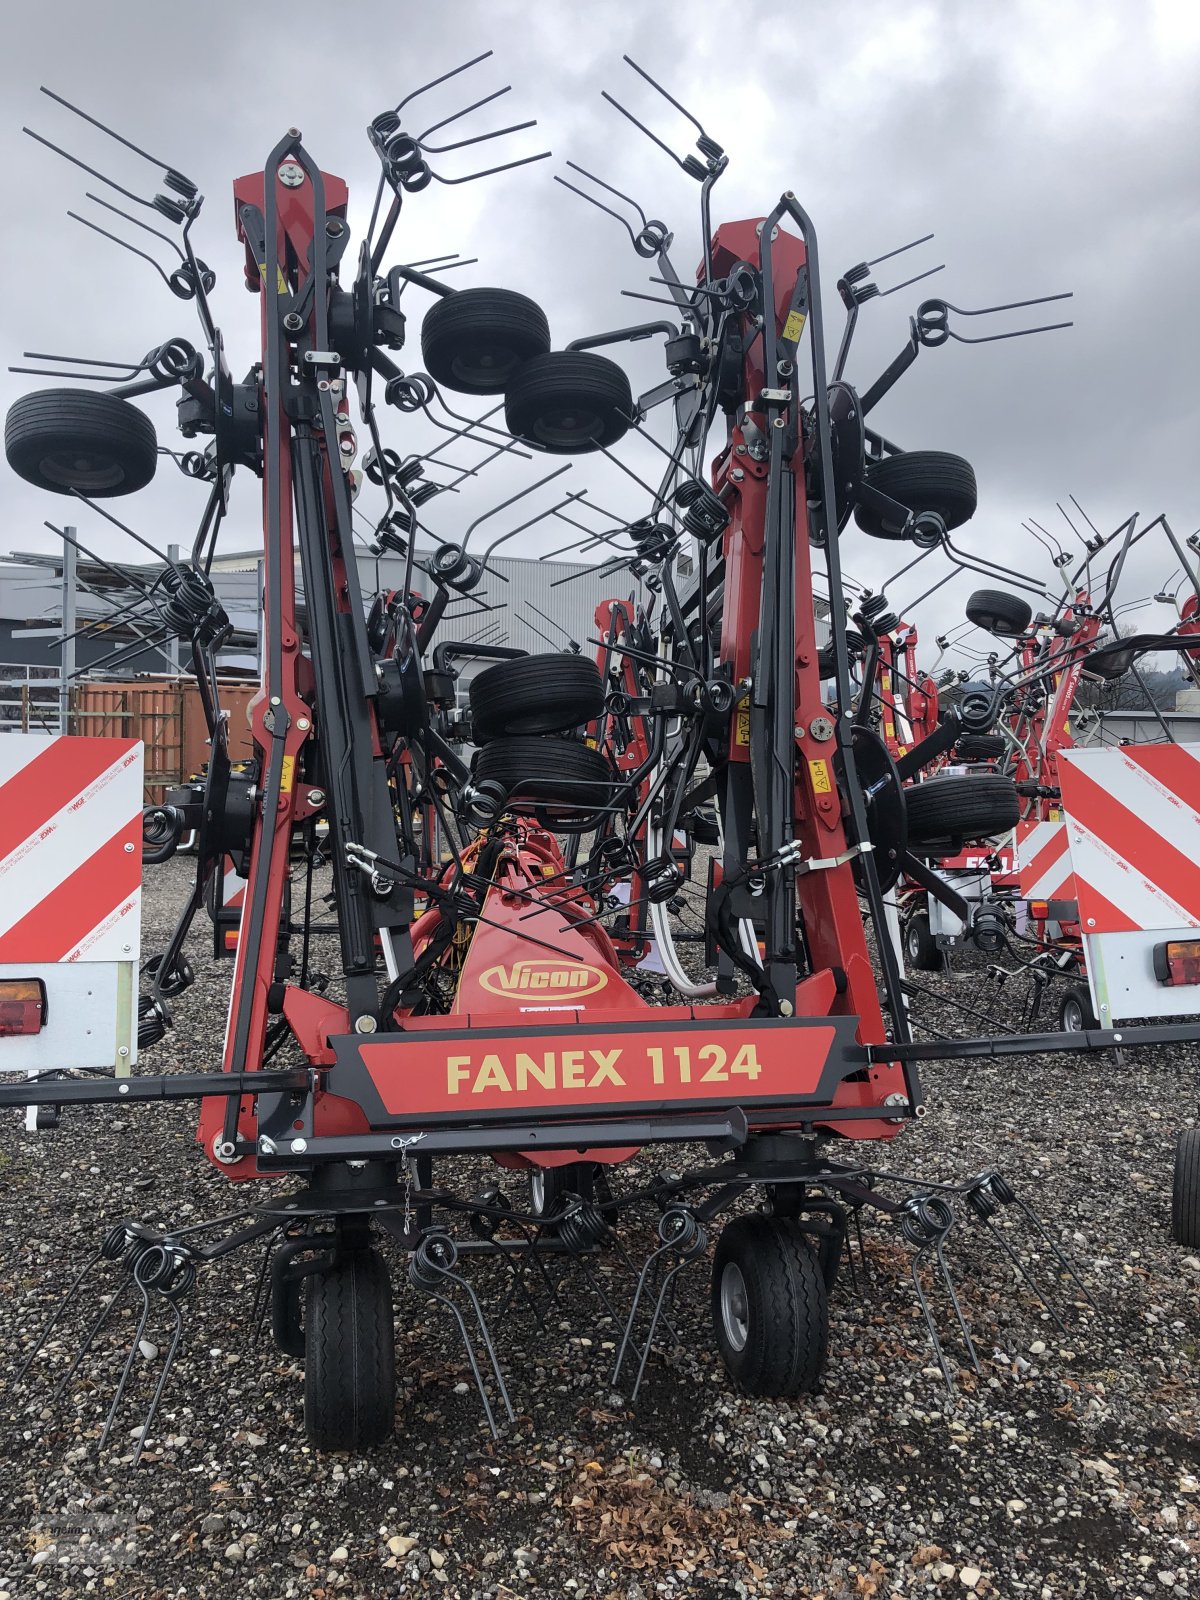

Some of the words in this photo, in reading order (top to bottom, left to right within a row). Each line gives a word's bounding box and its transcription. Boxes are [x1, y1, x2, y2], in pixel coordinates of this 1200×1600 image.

[122, 752, 136, 768] WGF
[71, 796, 86, 812] WGF
[39, 825, 54, 841] WGF
[120, 902, 134, 917] WGF
[496, 964, 589, 989] Vicon
[447, 1049, 627, 1095] FANEX
[647, 1044, 762, 1084] 1124
